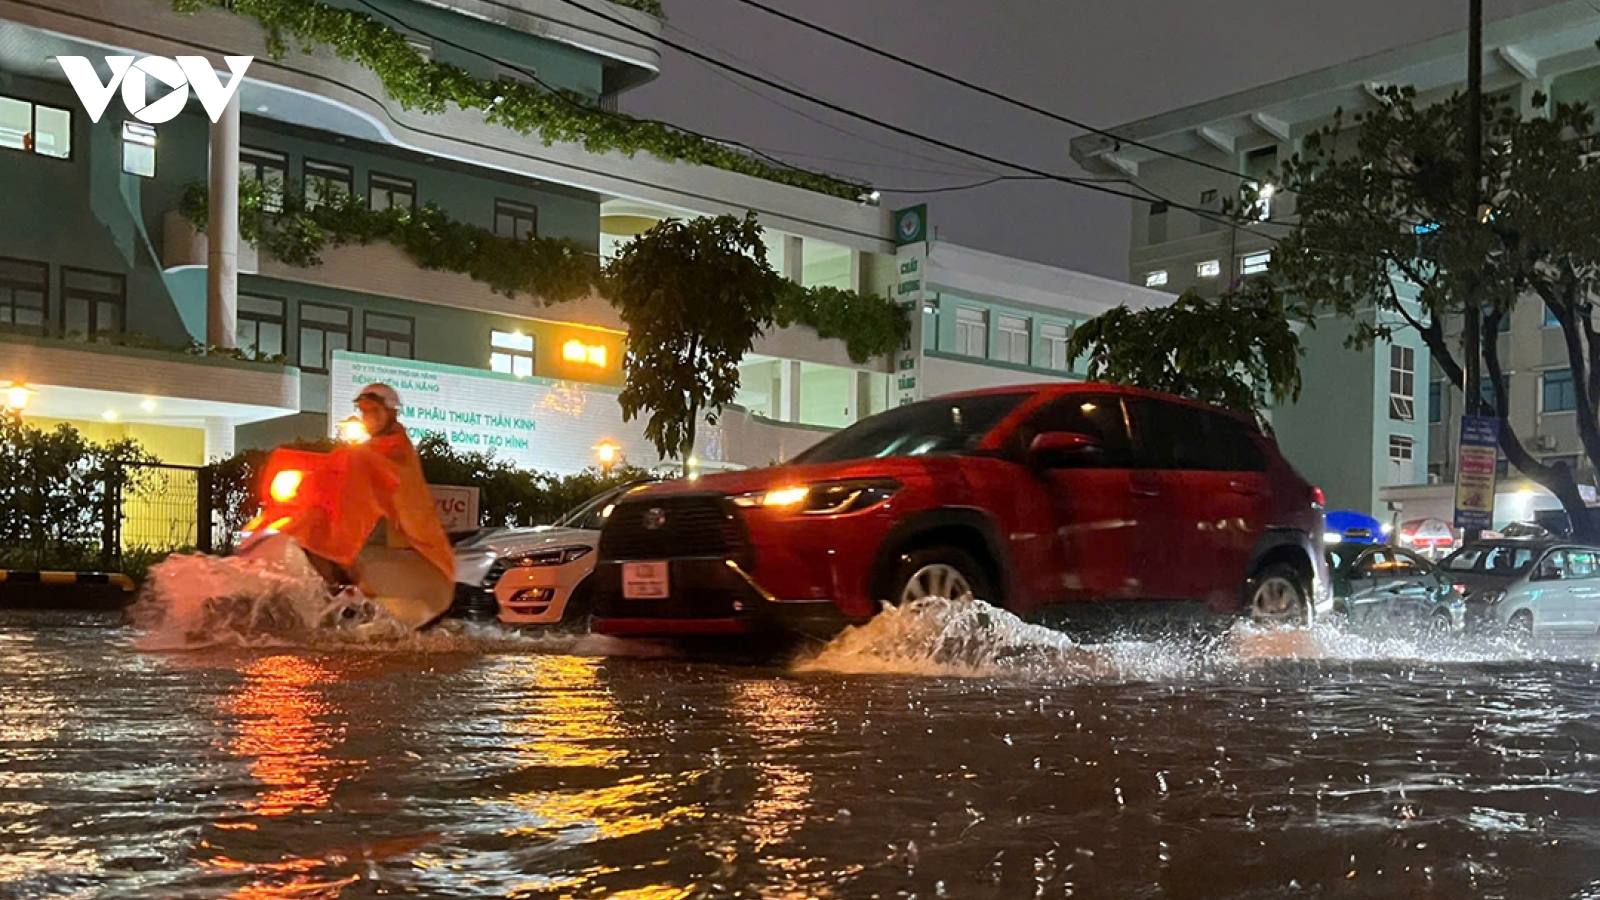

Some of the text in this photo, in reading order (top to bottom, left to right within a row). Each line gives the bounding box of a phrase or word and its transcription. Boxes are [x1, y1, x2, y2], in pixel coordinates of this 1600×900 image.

[448, 411, 481, 426] THUẬT
[513, 418, 536, 431] KINH
[505, 435, 529, 450] HÌNH
